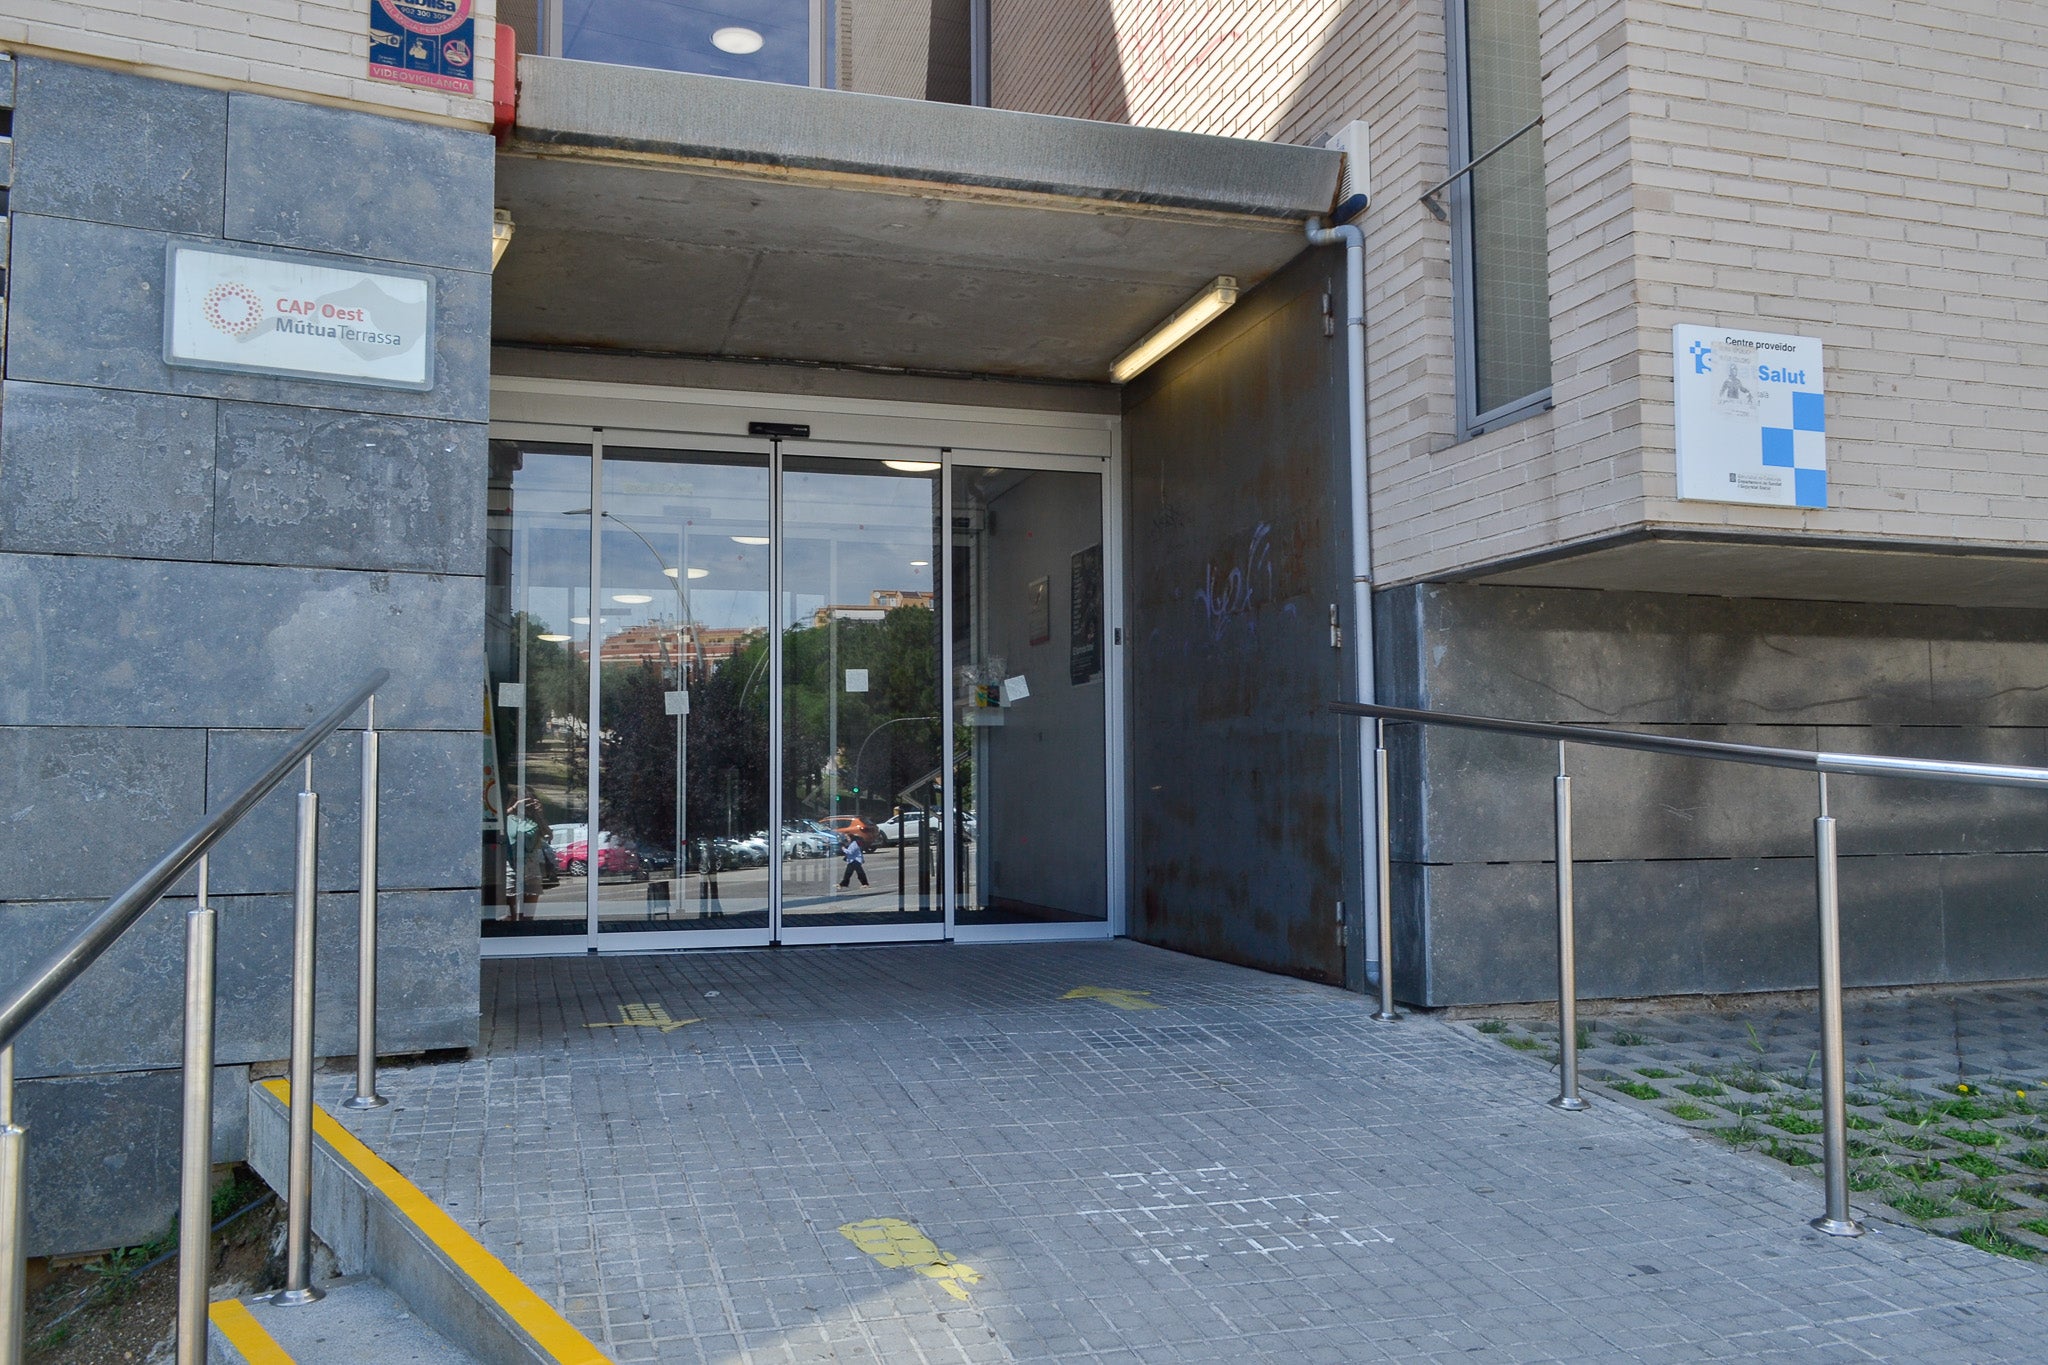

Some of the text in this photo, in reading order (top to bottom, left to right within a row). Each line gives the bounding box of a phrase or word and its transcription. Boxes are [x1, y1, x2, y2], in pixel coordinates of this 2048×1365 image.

[416, 9, 431, 18] 300
[373, 67, 470, 91] VIDEOVIGILANCIA
[276, 298, 364, 322] CAP Oest
[1725, 336, 1754, 348] Centre
[1756, 342, 1796, 353] proveïdor
[1758, 364, 1805, 385] Salut
